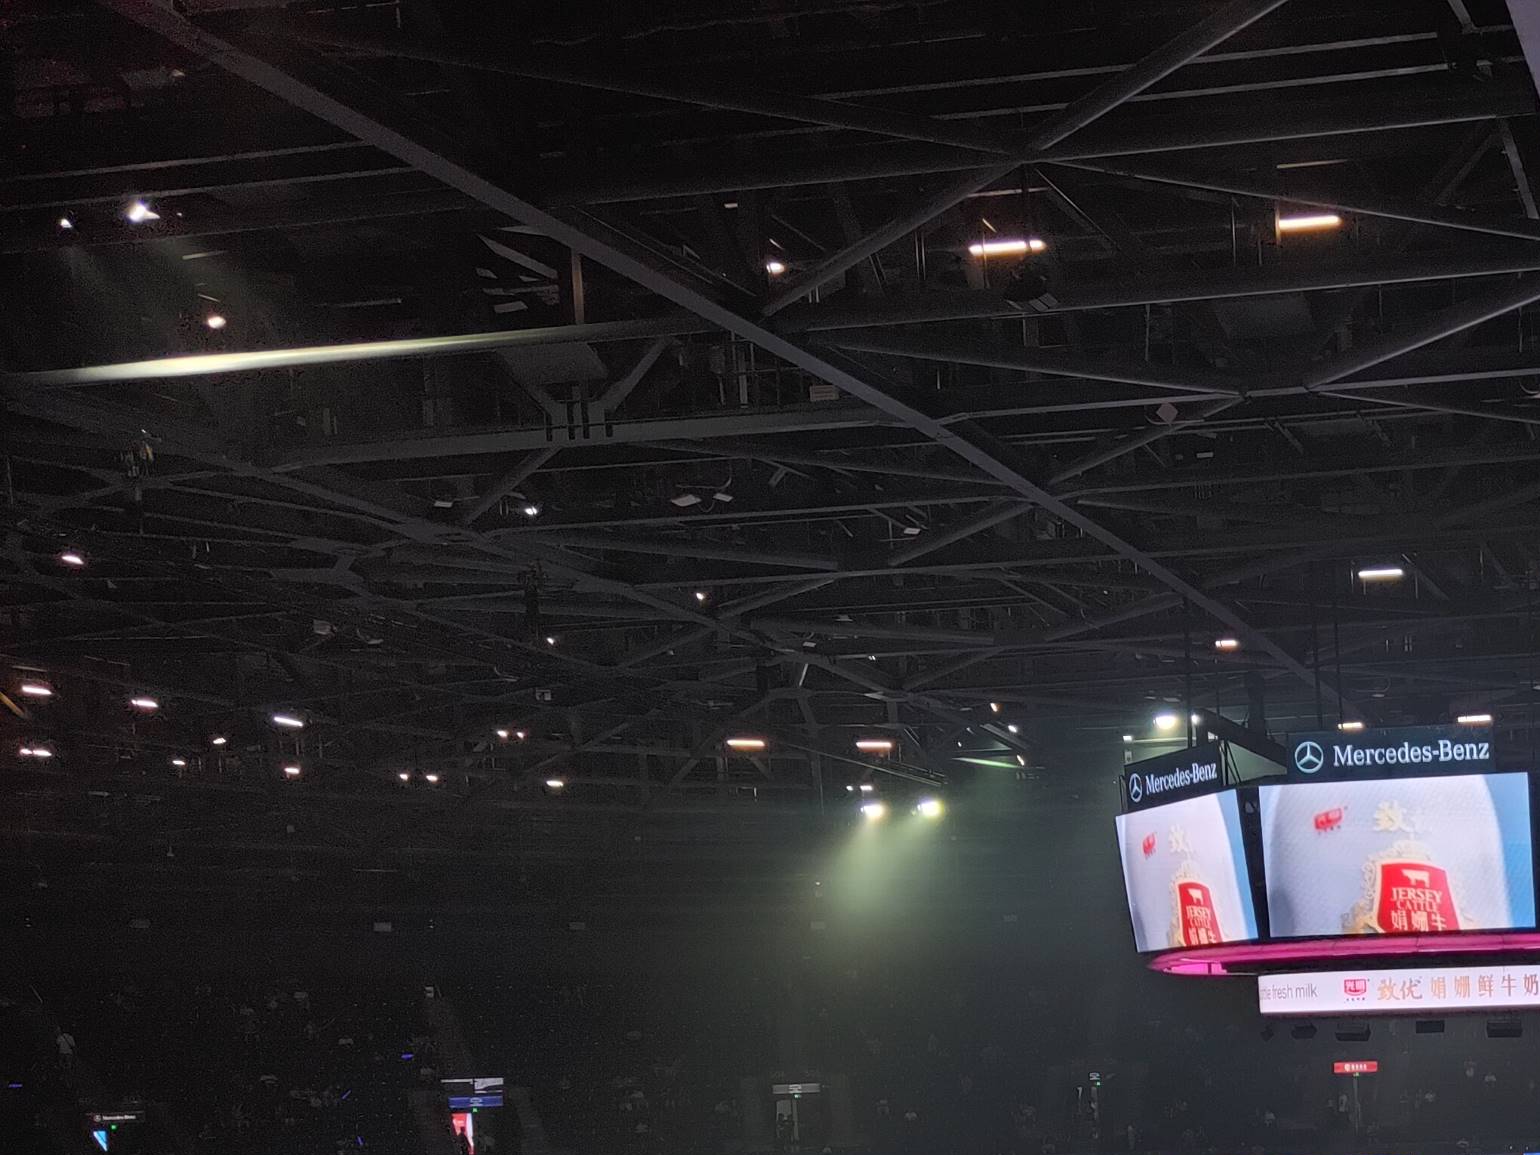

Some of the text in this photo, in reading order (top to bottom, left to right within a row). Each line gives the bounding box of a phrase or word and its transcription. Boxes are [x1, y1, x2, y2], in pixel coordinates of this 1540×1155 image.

[1333, 739, 1490, 767] Mercedes-Benz
[1145, 762, 1218, 796] Mercedes-Benz
[1391, 887, 1443, 904] JERSEY
[1396, 900, 1440, 912] CATTLE
[1272, 986, 1293, 999] fresh
[1295, 983, 1318, 998] milk
